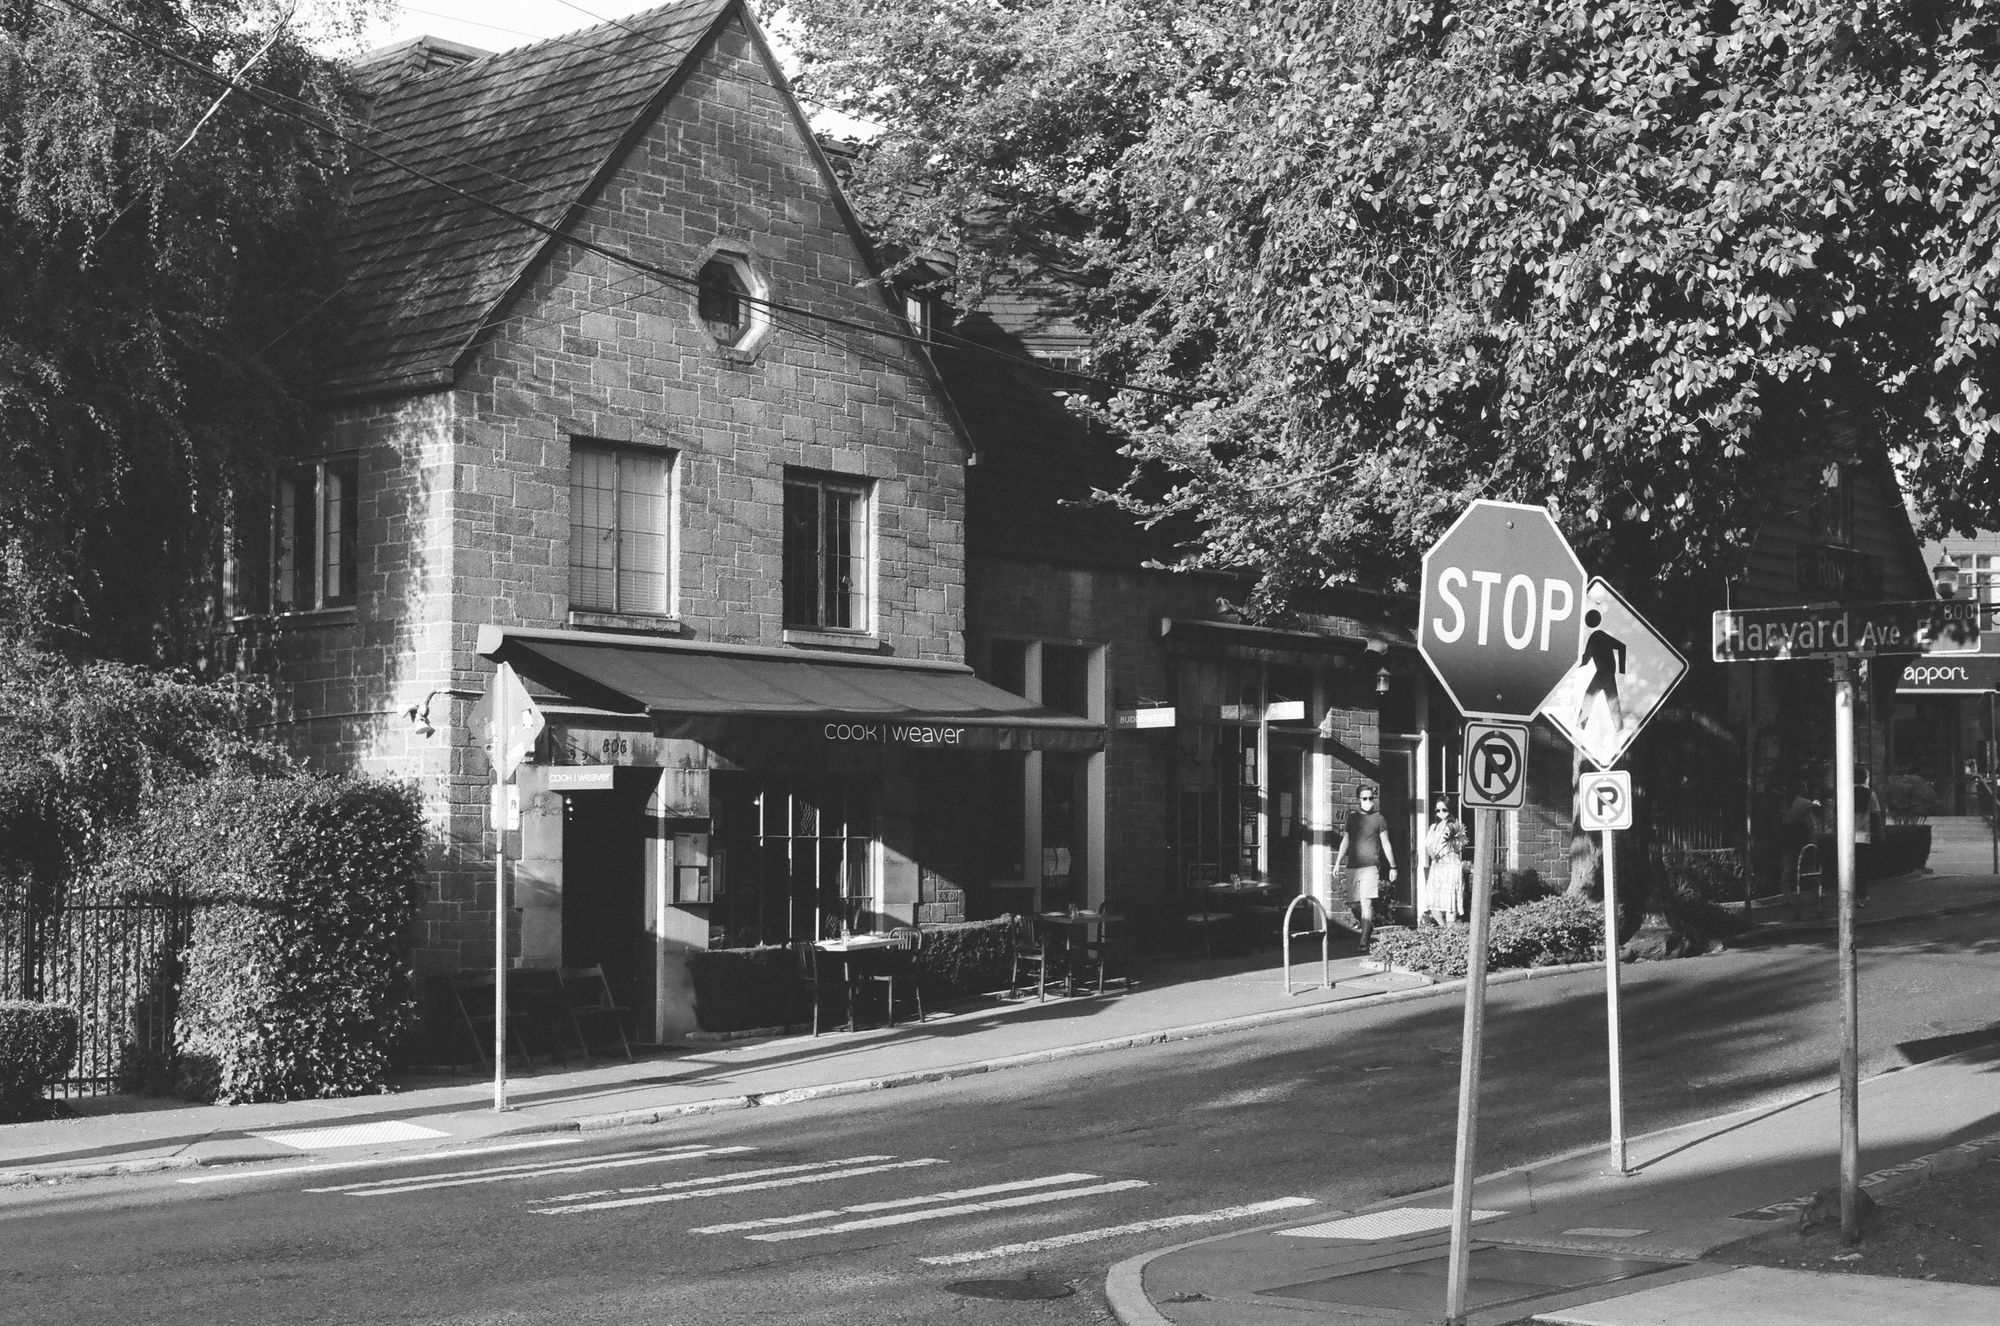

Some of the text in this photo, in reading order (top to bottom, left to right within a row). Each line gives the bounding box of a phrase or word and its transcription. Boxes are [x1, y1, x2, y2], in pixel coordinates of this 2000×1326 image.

[1432, 566, 1574, 652] STOP
[1943, 603, 1974, 621] 800
[1724, 611, 1933, 653] Harvard Ave E
[1903, 665, 1969, 685] apport
[892, 725, 965, 744] weaver
[602, 738, 628, 754] 806
[577, 773, 612, 783] weaver
